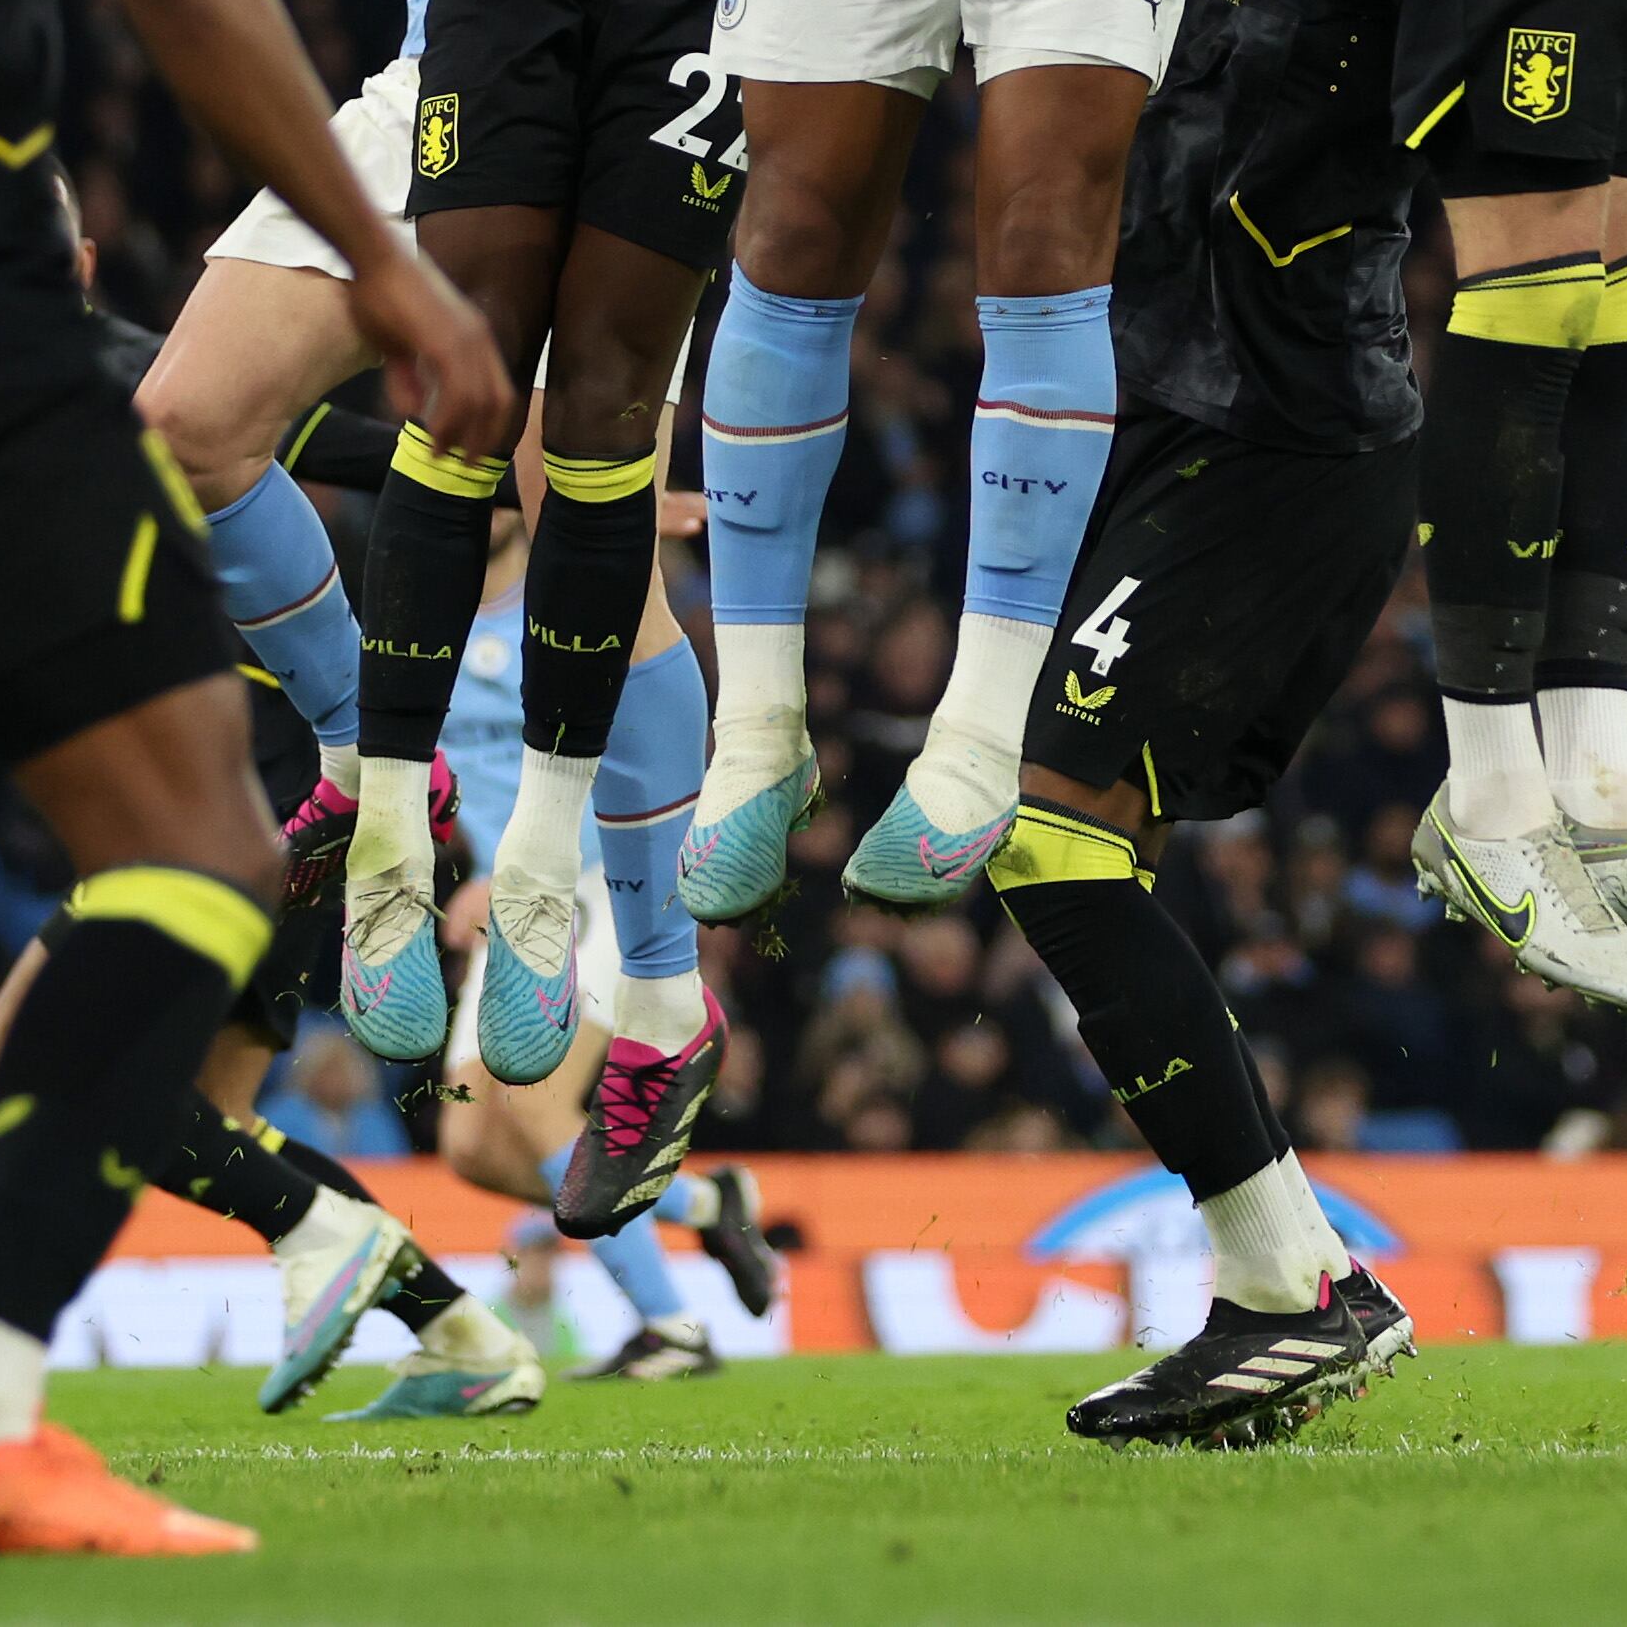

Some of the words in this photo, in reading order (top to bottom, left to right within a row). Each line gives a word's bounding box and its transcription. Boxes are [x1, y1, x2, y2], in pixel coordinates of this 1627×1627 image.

[1513, 34, 1570, 54] AVFC
[422, 98, 455, 117] AVFC
[982, 471, 1068, 494] CITY
[528, 614, 622, 653] VILLA
[1070, 575, 1142, 678] 4
[361, 635, 452, 660] VILLA
[1055, 702, 1102, 726] CASTORE
[1111, 1057, 1193, 1105] ILLA
